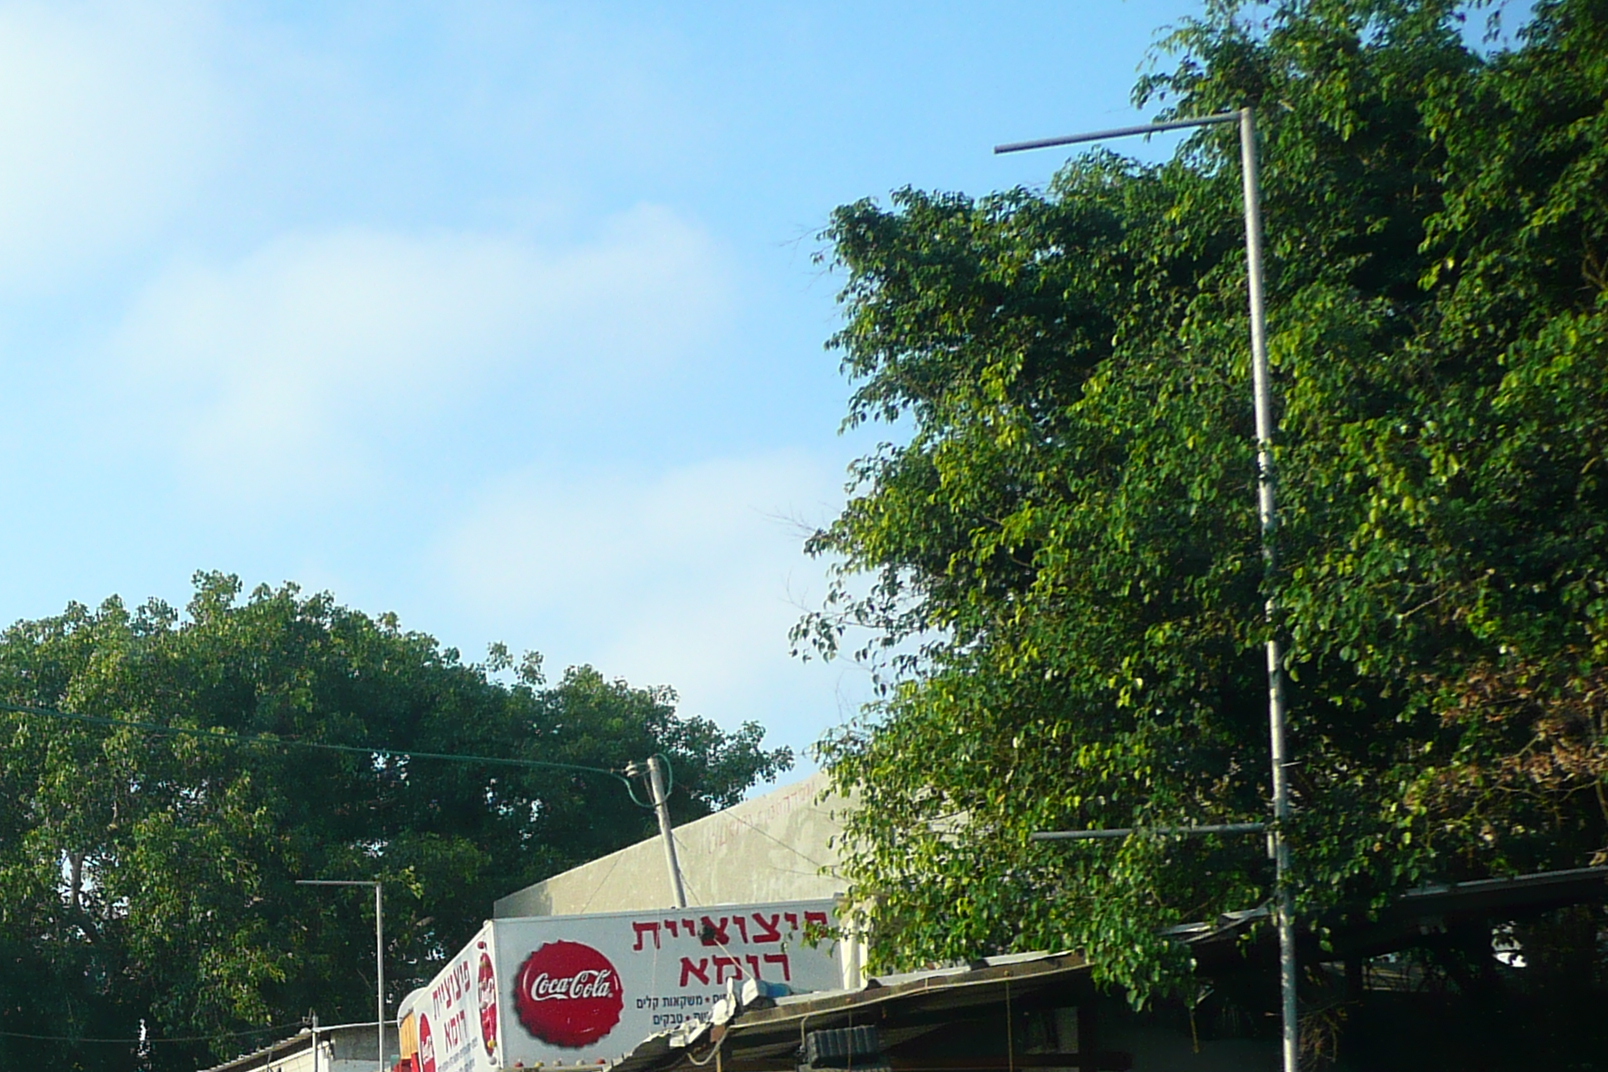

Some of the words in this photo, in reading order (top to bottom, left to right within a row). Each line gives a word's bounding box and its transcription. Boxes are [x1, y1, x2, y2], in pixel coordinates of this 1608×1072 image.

[632, 910, 828, 951] פיצוציית
[679, 953, 791, 987] רומא
[531, 969, 612, 1001] Coca-Cola
[636, 995, 659, 1011] קלים
[662, 994, 703, 1010] משקאות
[653, 1013, 683, 1027] טבקים
